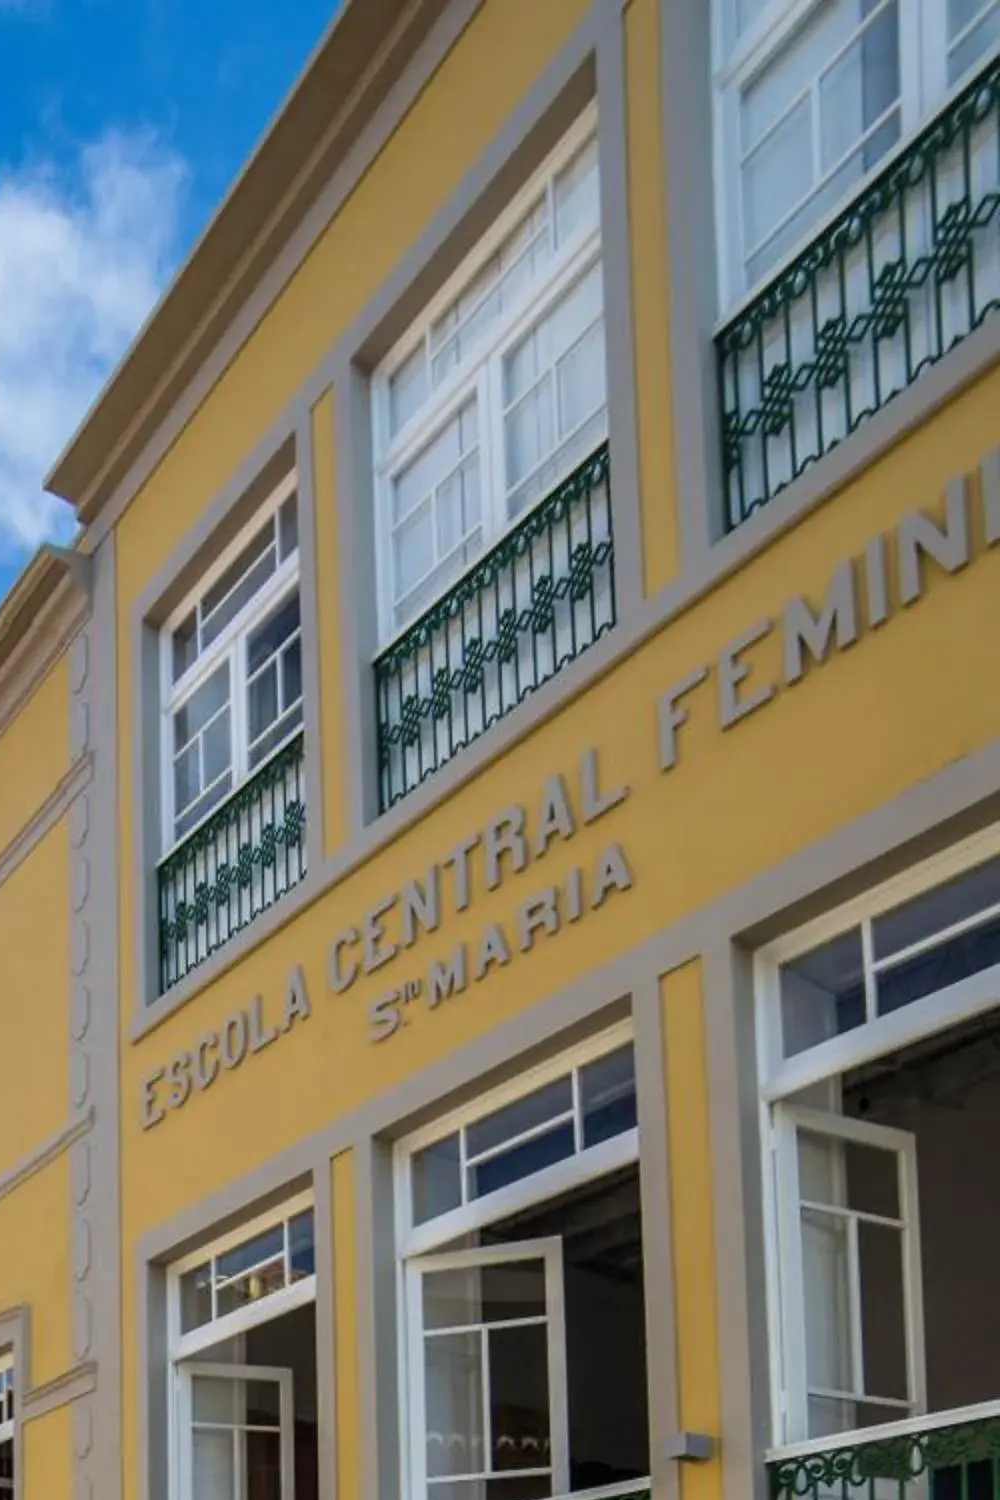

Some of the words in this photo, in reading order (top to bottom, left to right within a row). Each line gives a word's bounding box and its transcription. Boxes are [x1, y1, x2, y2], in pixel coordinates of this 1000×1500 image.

[140, 963, 312, 1130] ESCOLA
[325, 746, 632, 995] CENTRAL
[428, 842, 634, 1010] MARIA
